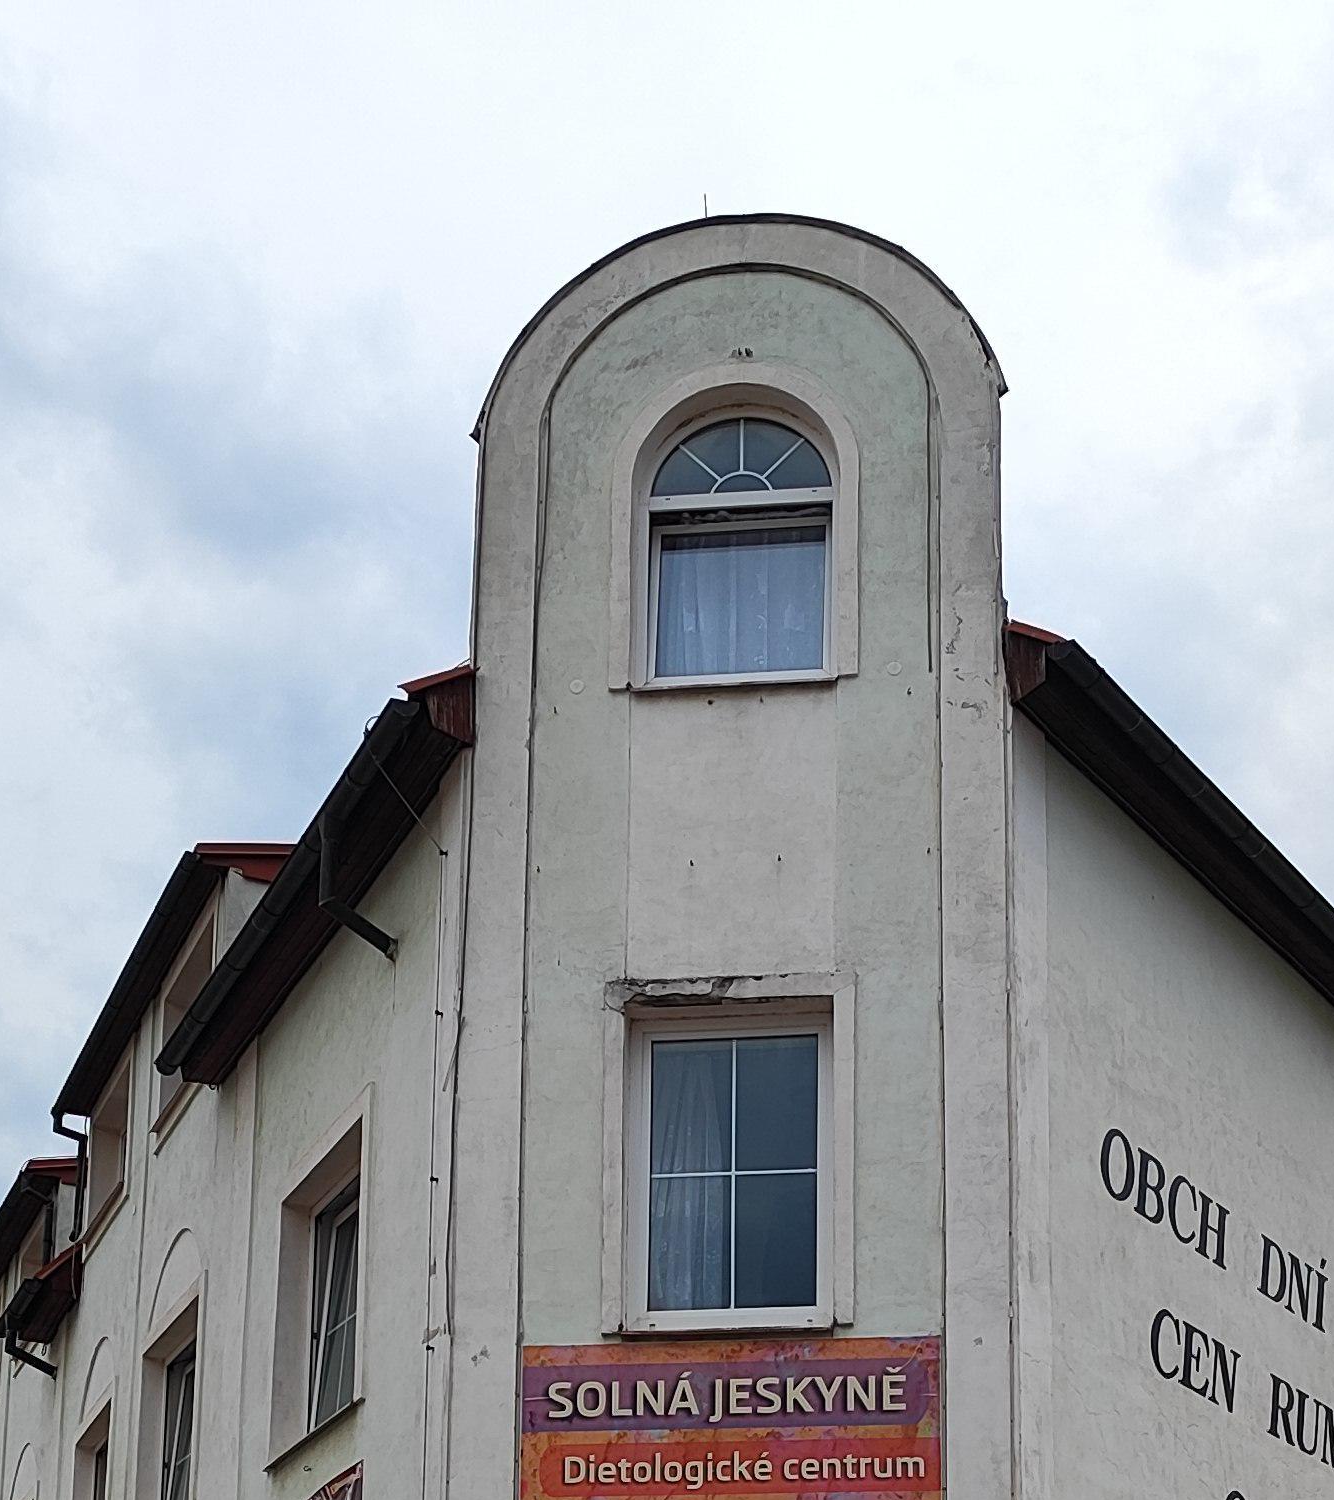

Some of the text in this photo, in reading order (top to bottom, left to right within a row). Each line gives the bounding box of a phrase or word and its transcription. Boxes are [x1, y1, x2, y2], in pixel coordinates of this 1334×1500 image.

[548, 1366, 907, 1423] SOLNÁ JESKYNĚ
[563, 1451, 926, 1490] Dietologické centrum
